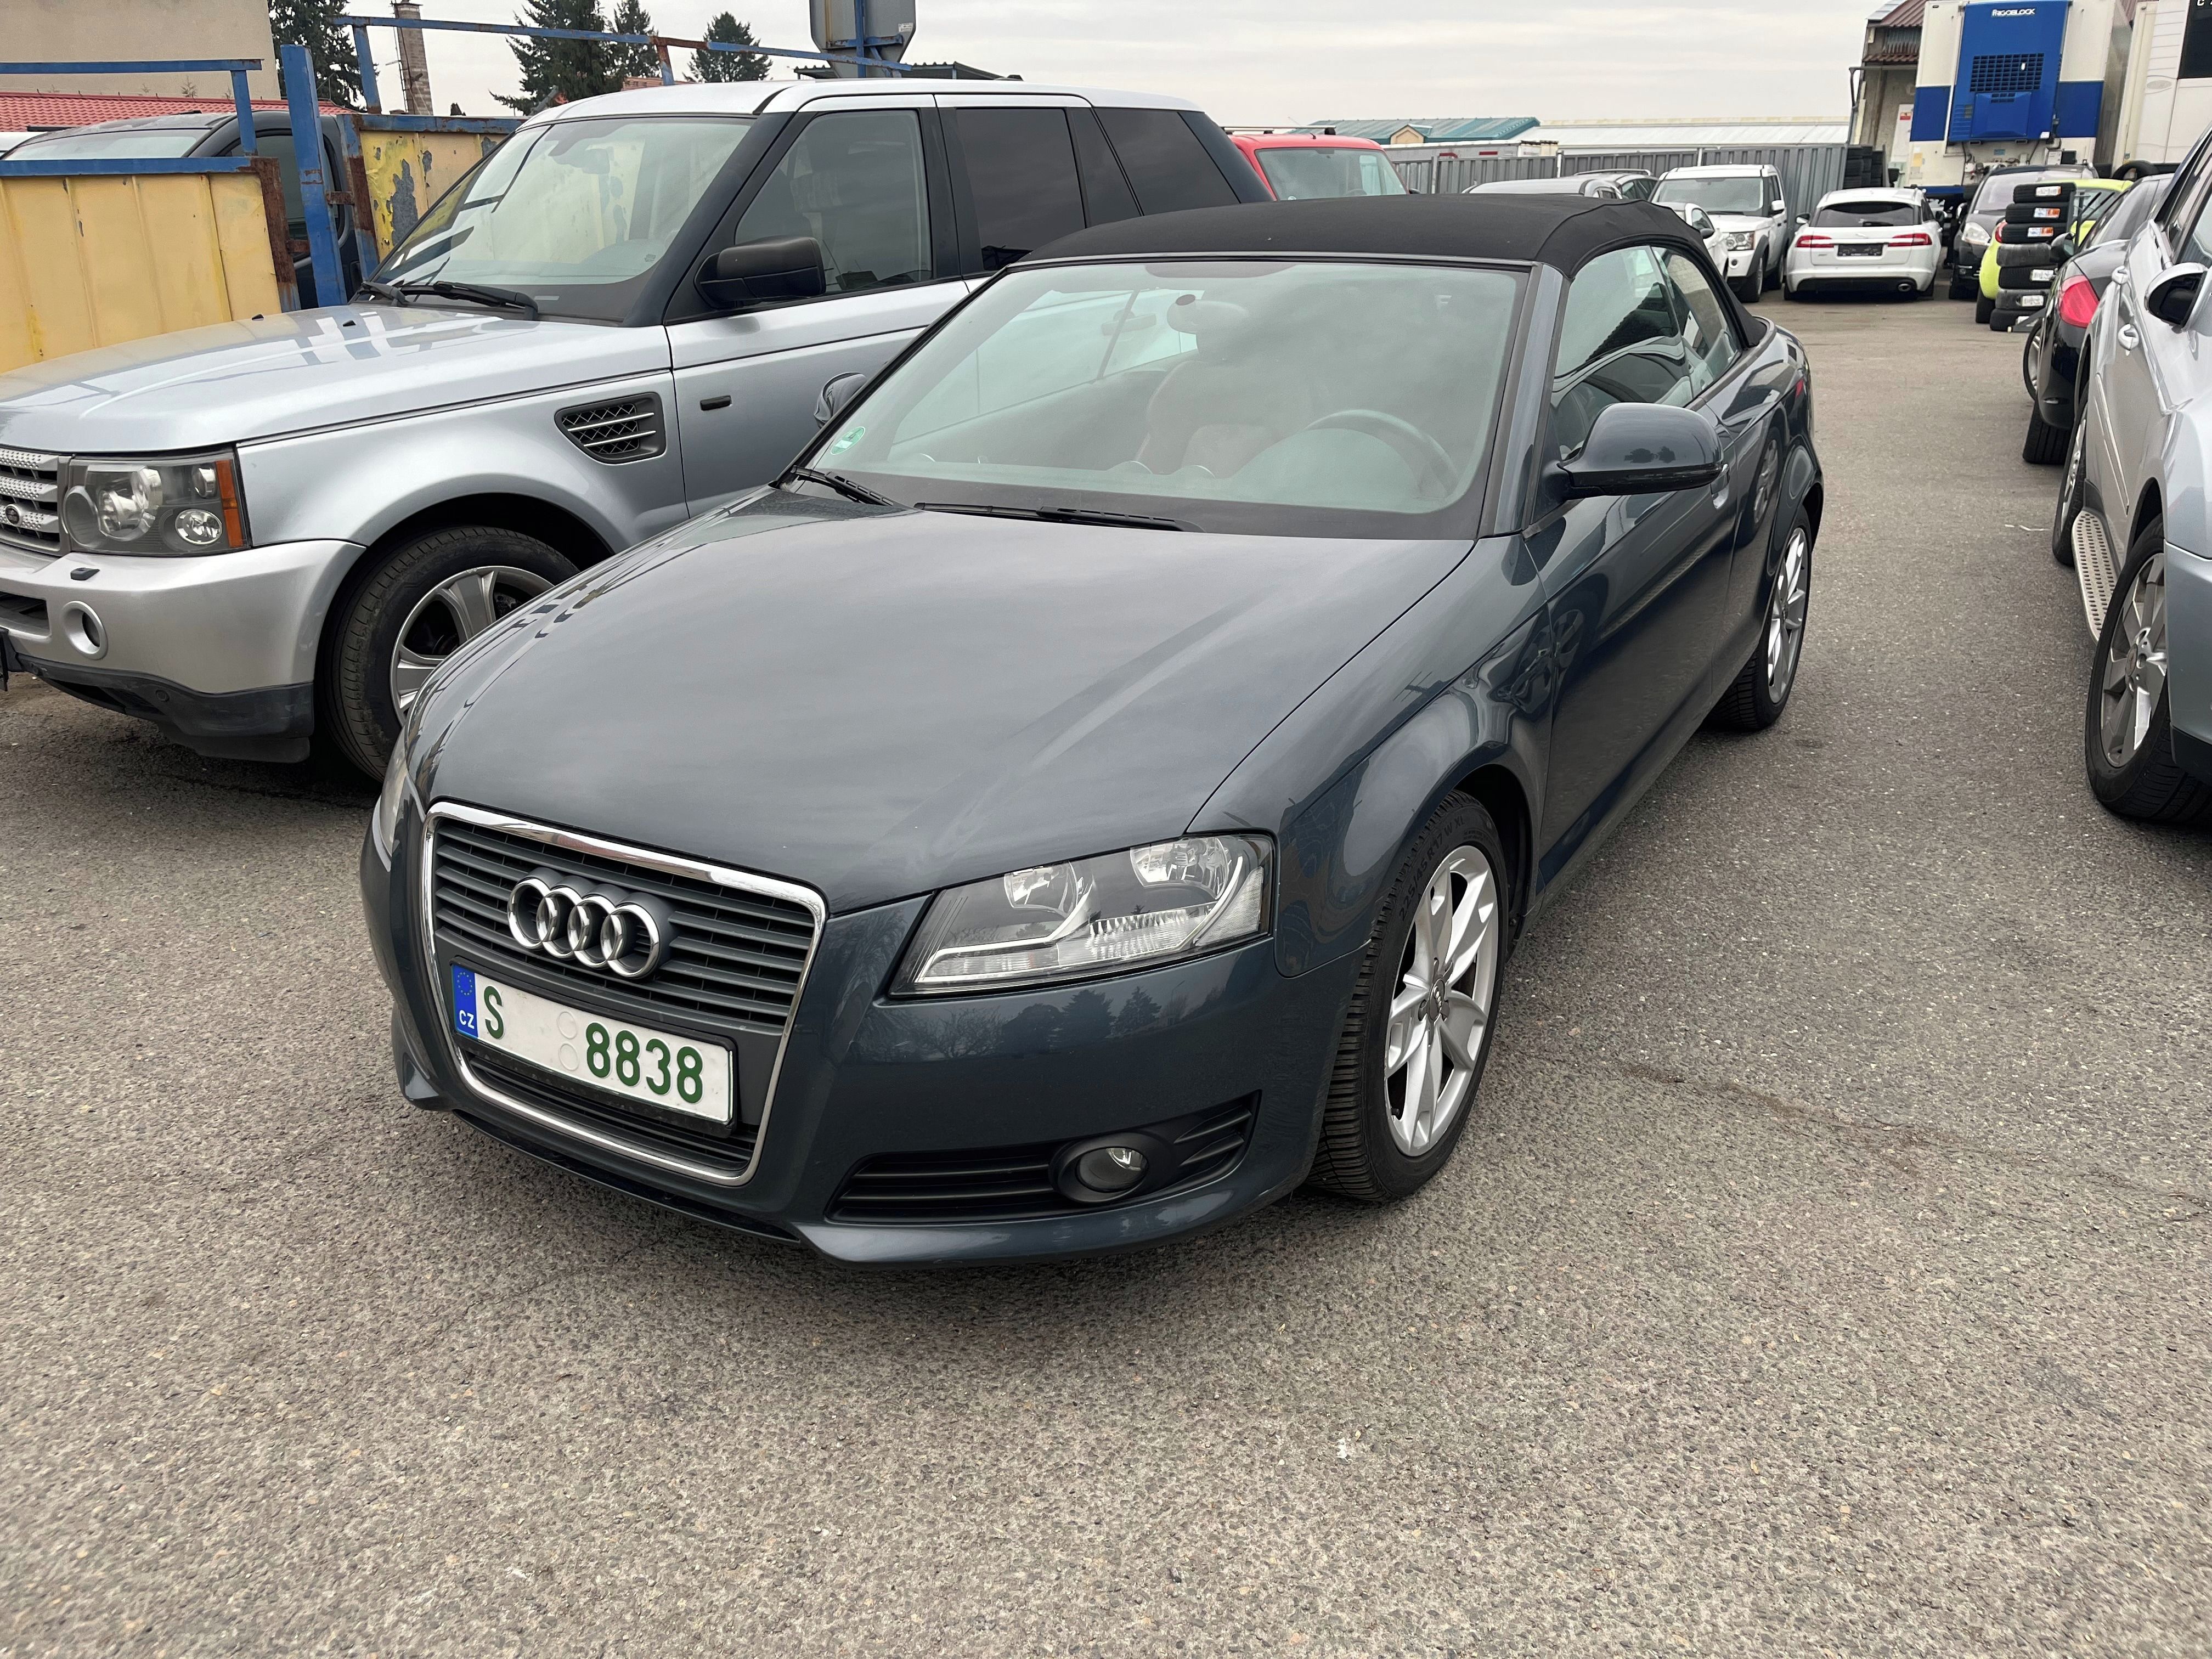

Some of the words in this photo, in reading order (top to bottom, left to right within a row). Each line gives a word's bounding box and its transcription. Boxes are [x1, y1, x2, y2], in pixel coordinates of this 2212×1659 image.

[1400, 861, 1428, 922] 225/45
[1454, 815, 1465, 829] XL
[459, 1009, 475, 1030] CZ
[483, 985, 505, 1040] S
[585, 1022, 704, 1104] 8838
